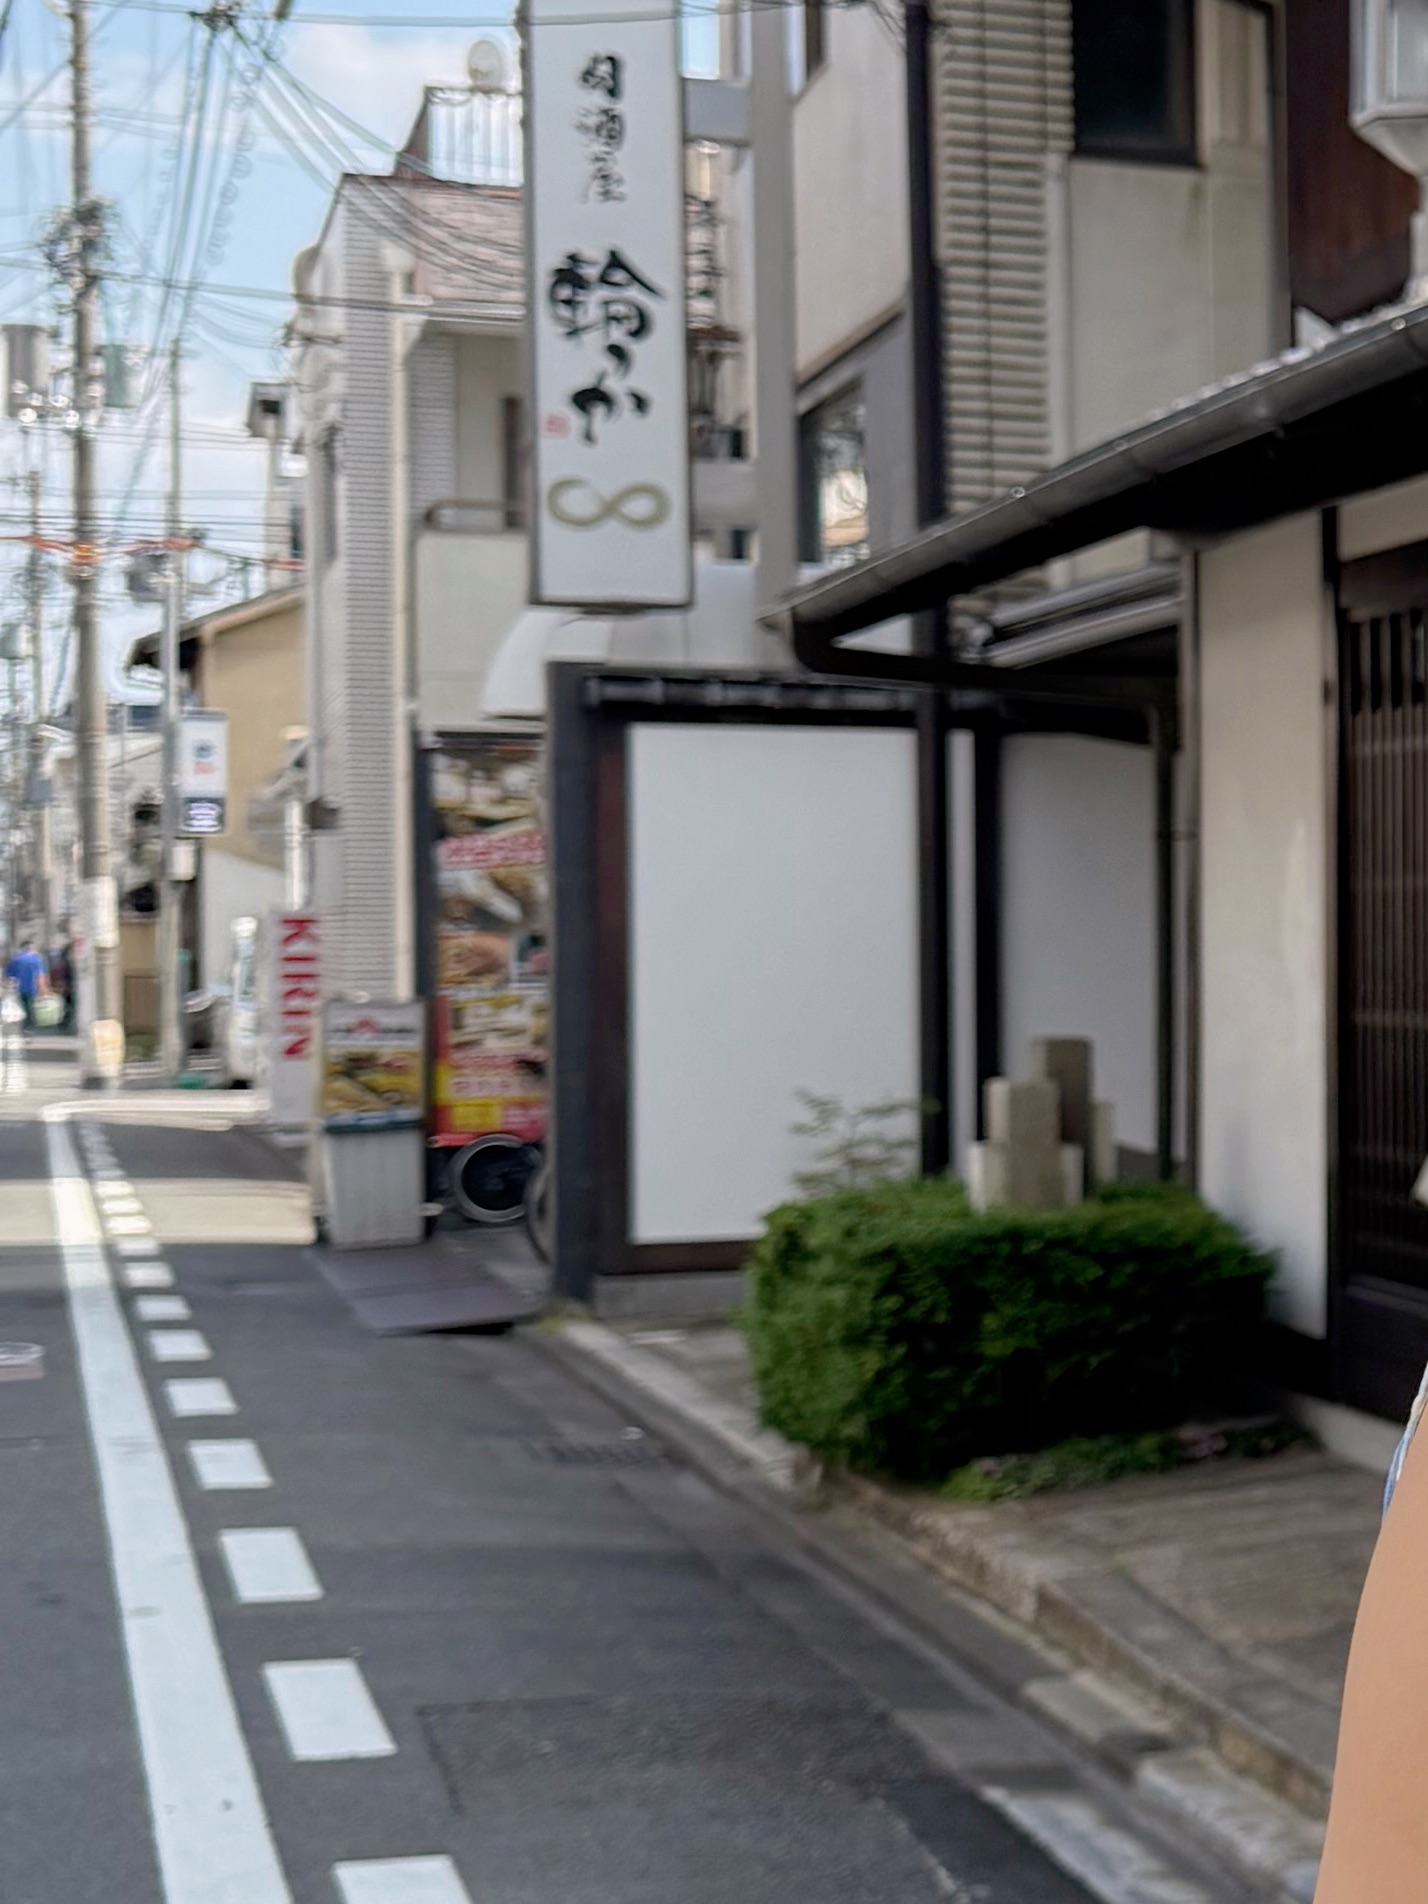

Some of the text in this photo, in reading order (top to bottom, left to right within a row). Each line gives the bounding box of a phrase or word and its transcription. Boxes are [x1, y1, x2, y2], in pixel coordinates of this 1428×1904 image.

[550, 248, 663, 443] 輪っか
[281, 918, 319, 1060] KIRIN
